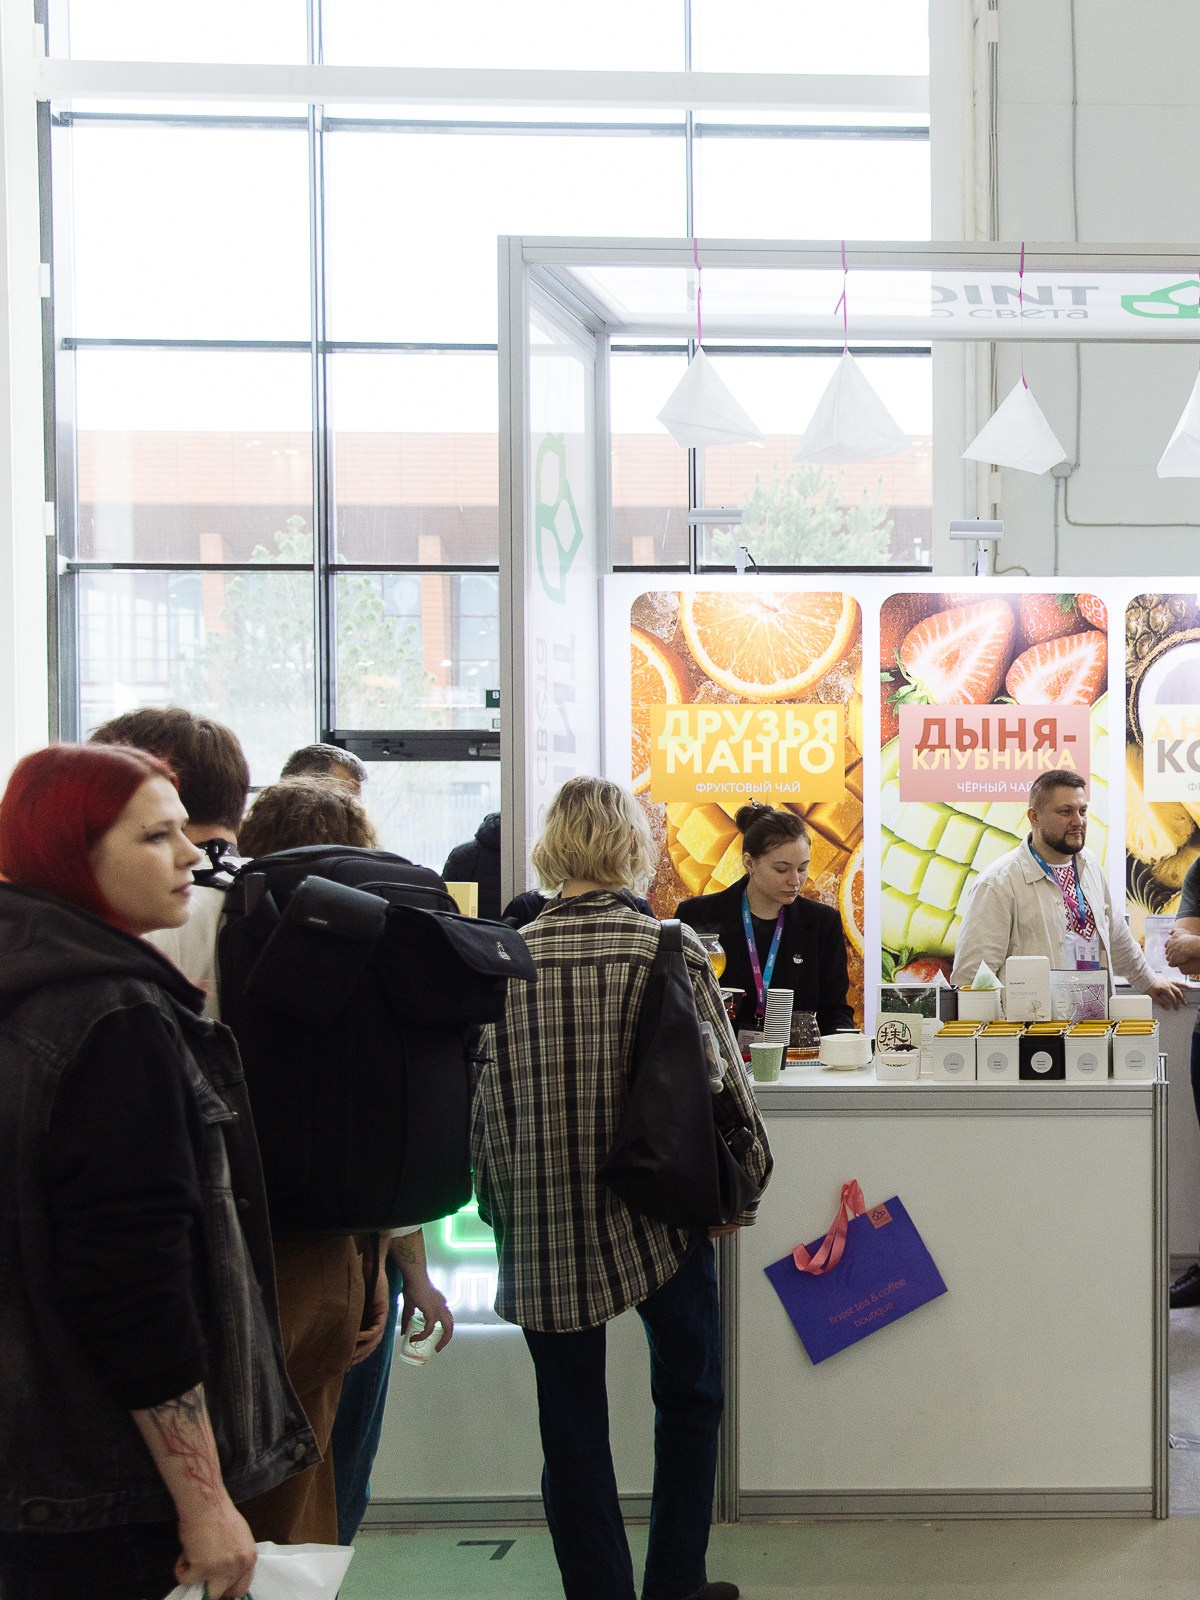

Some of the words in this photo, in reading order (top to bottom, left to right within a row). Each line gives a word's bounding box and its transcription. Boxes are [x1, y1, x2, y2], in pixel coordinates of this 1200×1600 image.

[658, 709, 838, 750] ДРУЗЬЯ
[915, 717, 1077, 757] ДЫНЯ-
[666, 739, 836, 774] МАНГО
[912, 748, 1077, 771] КЛУБНИКА
[695, 780, 772, 793] ФРУКТОВЫЙ
[775, 781, 801, 793] ЧАЙ
[957, 780, 1007, 793] ЧЁРНЫЙ
[828, 1307, 855, 1326] finest
[855, 1298, 870, 1311] tea
[879, 1279, 906, 1298] coffee
[854, 1302, 894, 1328] boutique
